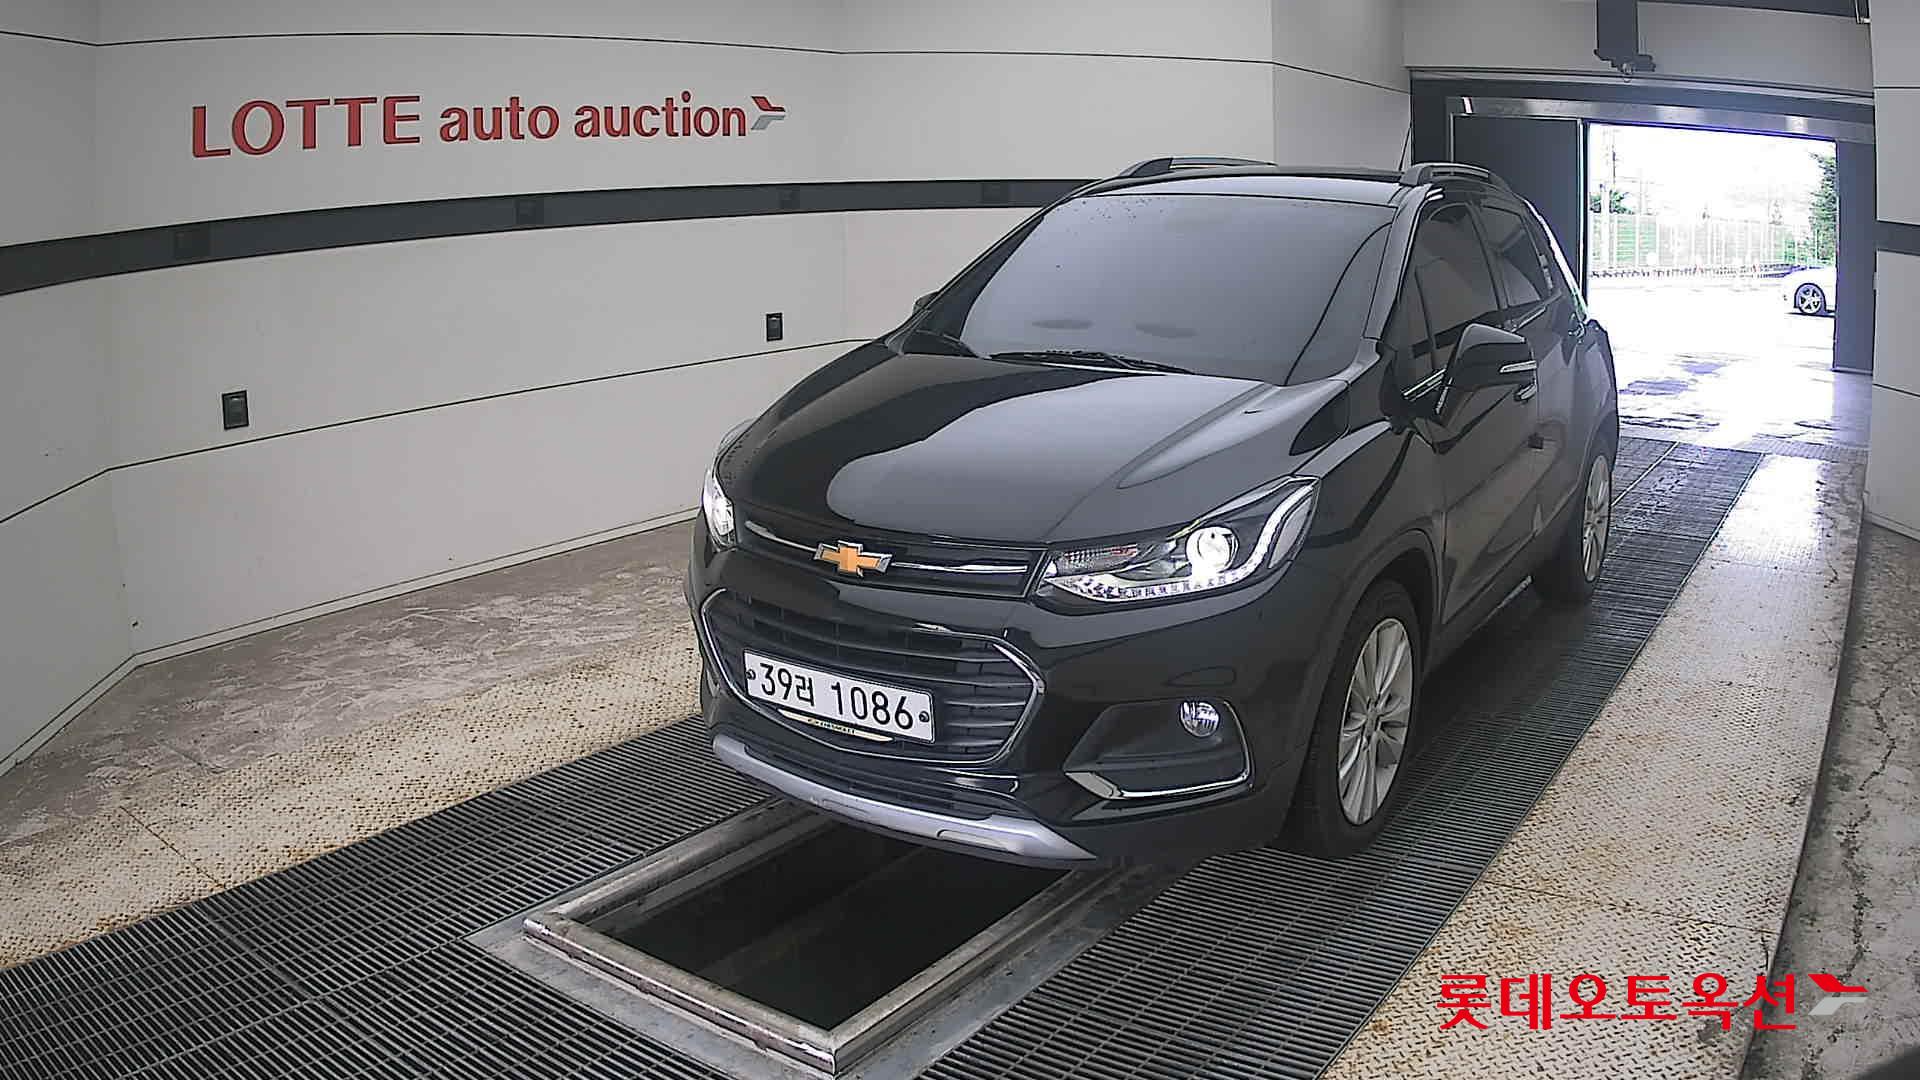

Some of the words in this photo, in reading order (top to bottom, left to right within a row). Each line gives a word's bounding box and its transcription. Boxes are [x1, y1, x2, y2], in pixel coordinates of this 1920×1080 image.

[191, 95, 421, 159] LOTTE
[439, 96, 560, 142] auto
[573, 90, 747, 138] auction
[759, 662, 815, 707] 39러
[831, 681, 914, 730] 1086
